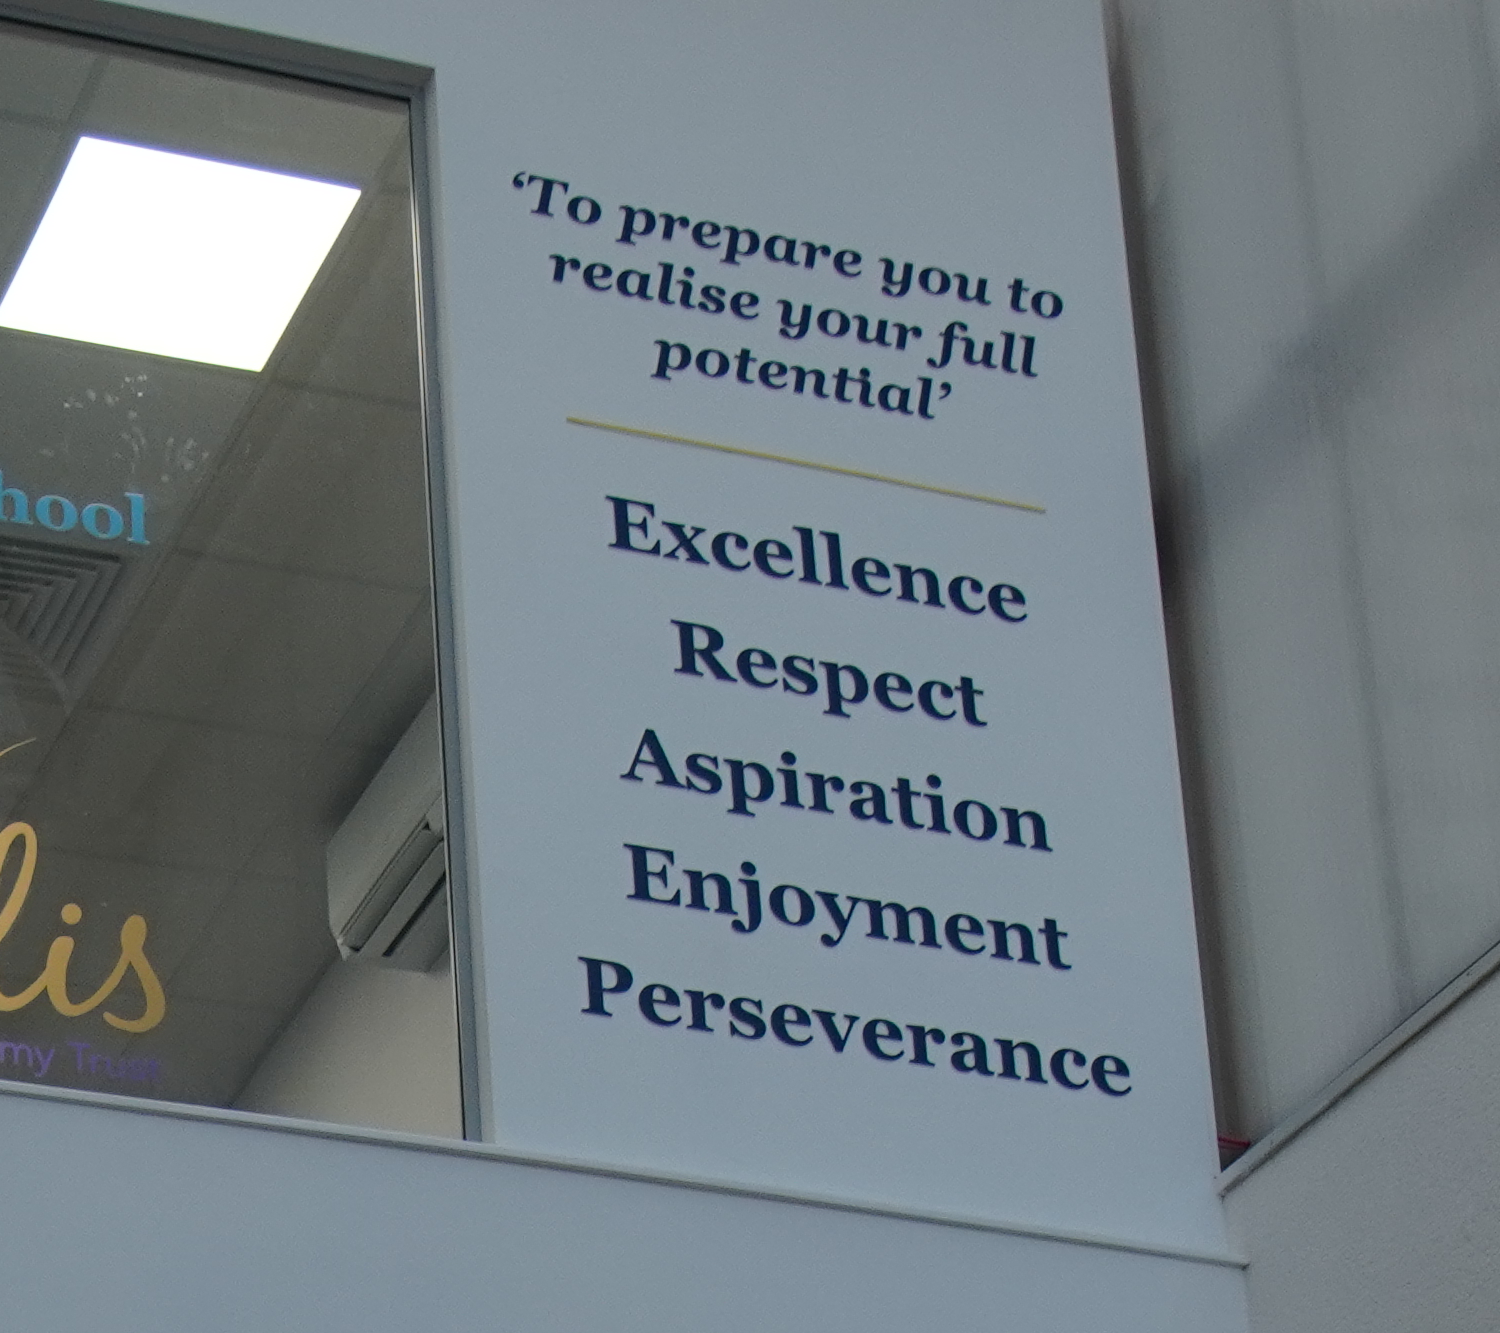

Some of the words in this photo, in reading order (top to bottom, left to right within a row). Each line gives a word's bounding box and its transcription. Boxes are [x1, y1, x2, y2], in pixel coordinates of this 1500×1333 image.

[550, 252, 760, 320] realise
[777, 298, 922, 351] your
[927, 322, 1039, 378] full
[616, 204, 863, 277] prepare
[879, 256, 991, 306] you
[1008, 277, 1064, 320] to
[605, 495, 1029, 622] Excellence
[671, 619, 988, 727] Respect
[620, 728, 1053, 852] Aspiration
[623, 843, 1072, 970] Enjoyment
[577, 956, 1132, 1097] Perseverance
